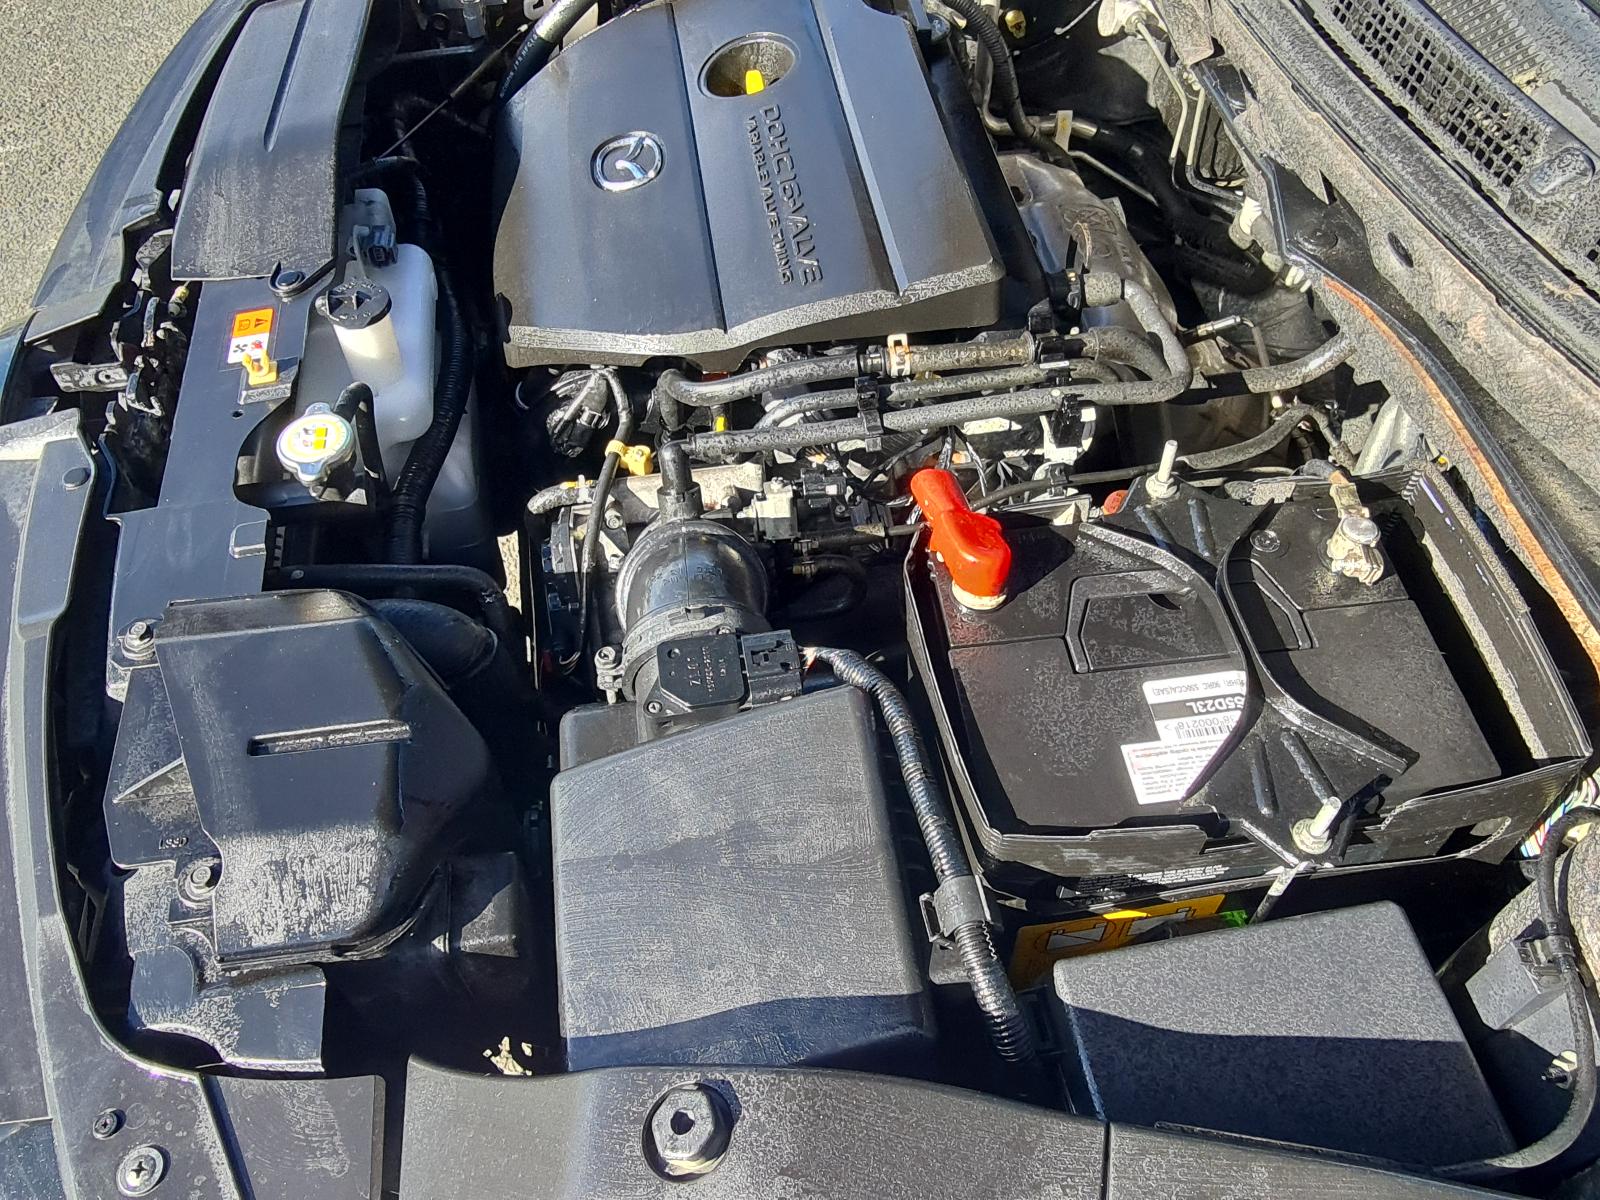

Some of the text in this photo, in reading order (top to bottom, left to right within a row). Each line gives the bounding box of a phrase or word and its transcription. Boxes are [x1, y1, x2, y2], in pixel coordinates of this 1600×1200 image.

[760, 103, 794, 174] DOHC
[745, 115, 794, 285] VARIABLE VALVE TIMING
